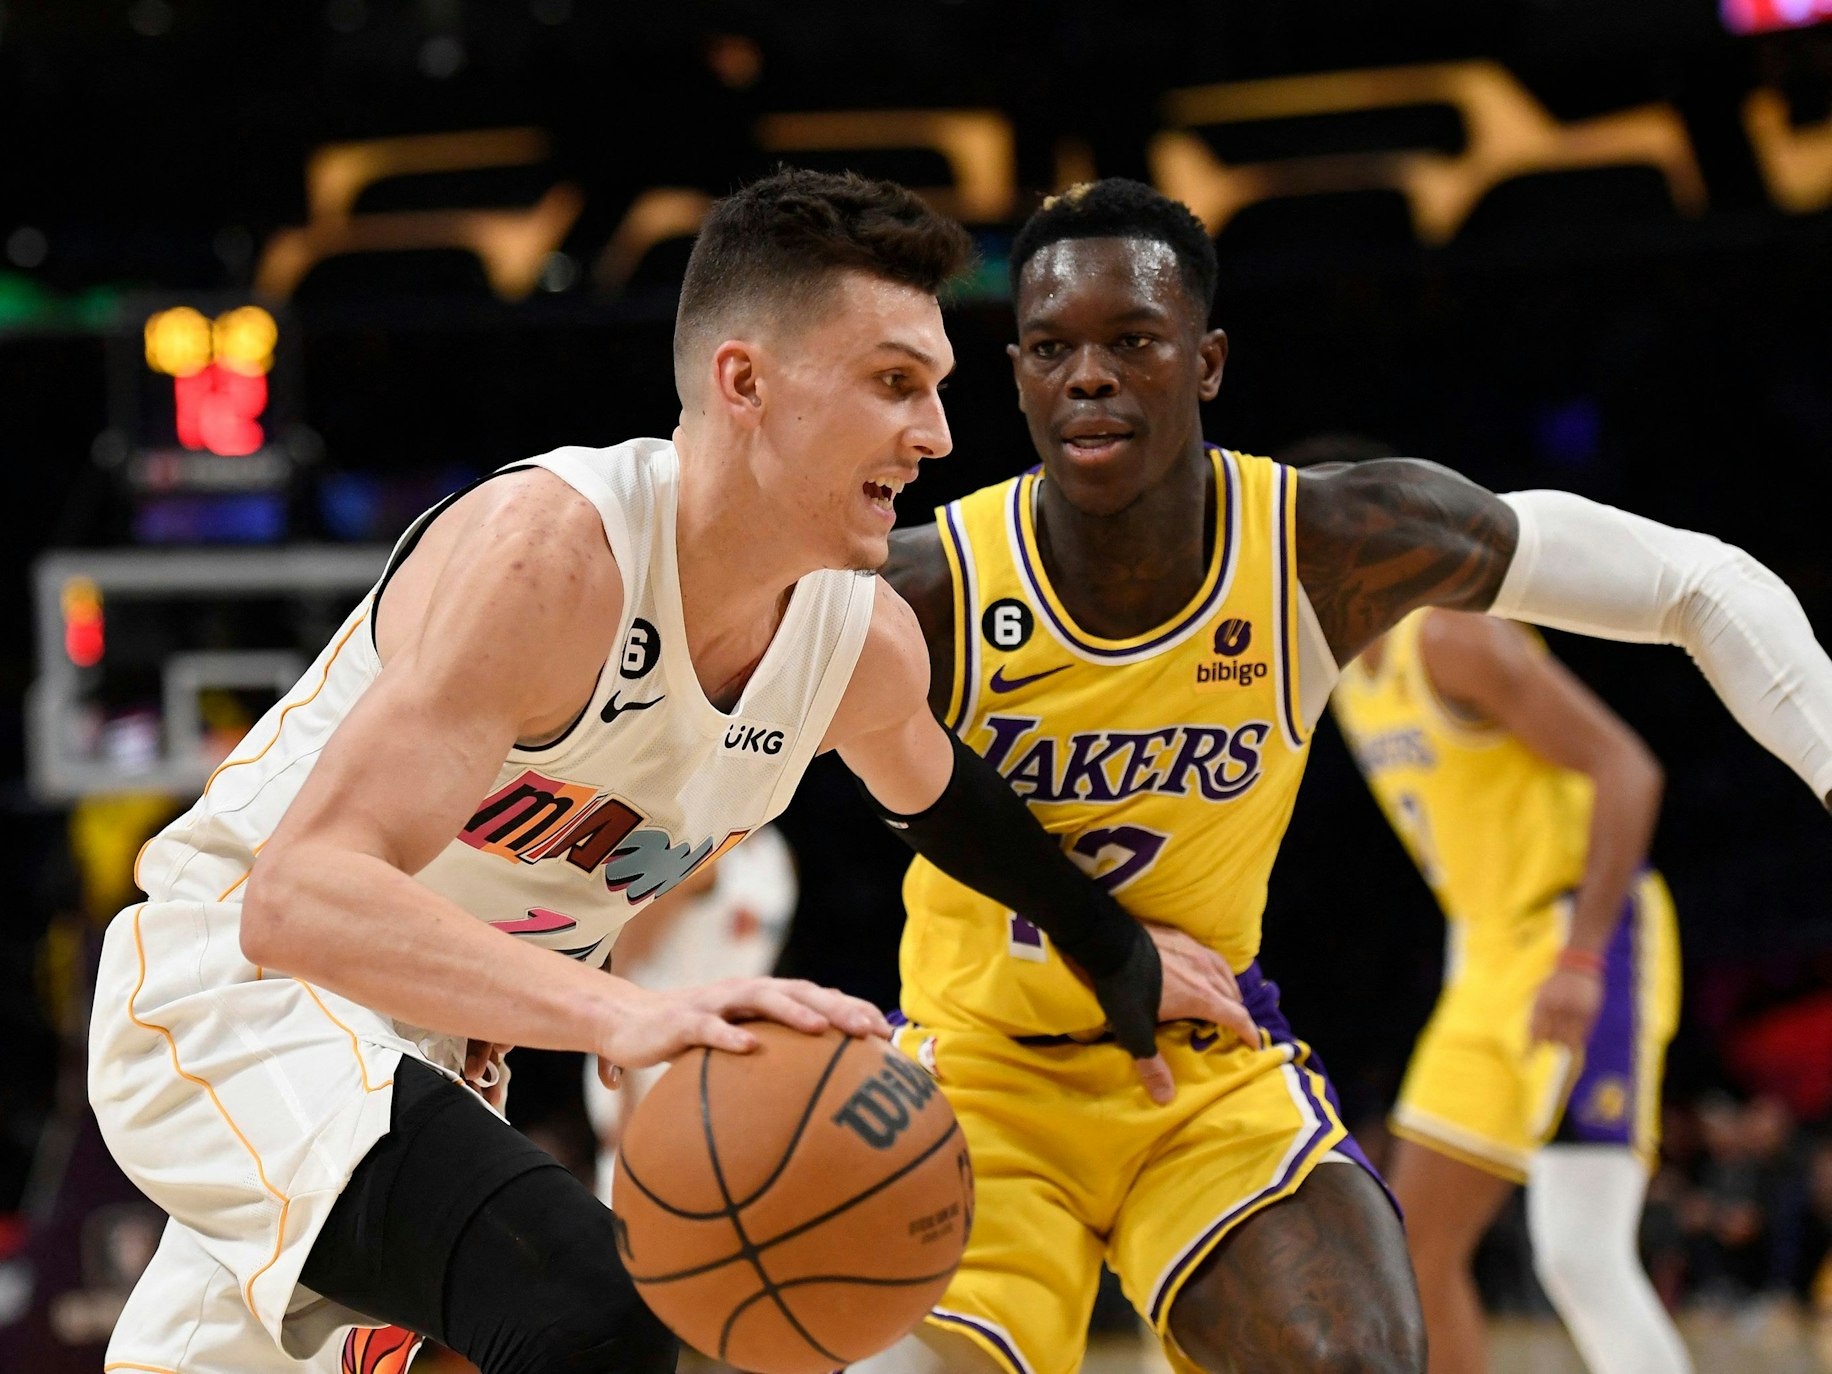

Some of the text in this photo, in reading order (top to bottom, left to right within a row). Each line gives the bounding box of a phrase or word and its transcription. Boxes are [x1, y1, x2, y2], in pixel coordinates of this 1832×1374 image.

[994, 605, 1022, 646] 6
[622, 627, 649, 672] 6
[1197, 660, 1267, 686] bibigo
